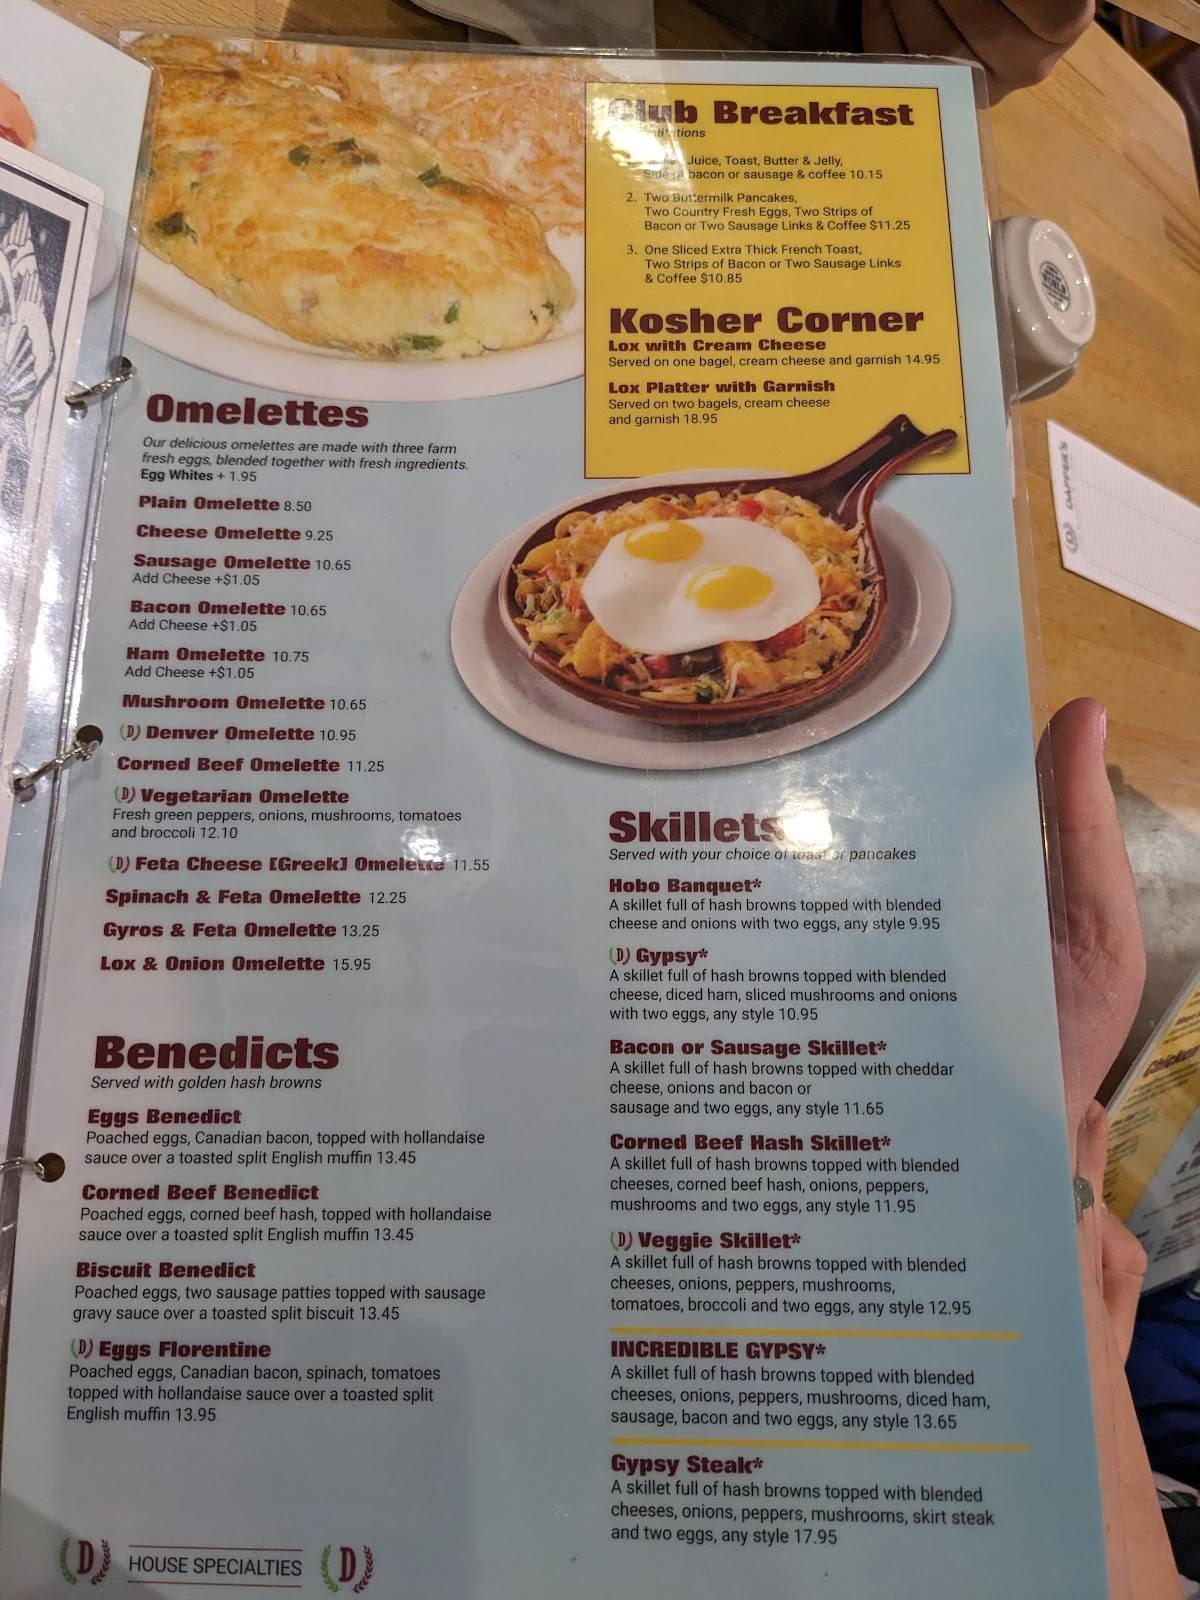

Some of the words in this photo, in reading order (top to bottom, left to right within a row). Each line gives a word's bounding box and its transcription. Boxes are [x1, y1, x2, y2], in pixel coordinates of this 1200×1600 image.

[608, 98, 698, 123] Club
[713, 100, 914, 126] Breakfast
[687, 155, 721, 166] Juice,
[724, 155, 760, 167] Toast,
[763, 155, 799, 166] Butter
[802, 155, 810, 165] &
[813, 155, 843, 168] Jelly,
[644, 220, 681, 231] Bacon
[684, 222, 696, 231] or
[699, 220, 725, 230] Two
[727, 220, 778, 233] Sausage
[781, 220, 813, 230] Links
[816, 220, 824, 230] &
[827, 220, 866, 230] Coffee
[870, 219, 910, 231] $11.25
[627, 244, 637, 255] 3.
[644, 245, 668, 255] One
[672, 244, 708, 255] Sliced
[711, 244, 742, 255] Extra
[744, 244, 778, 254] Thick
[781, 244, 822, 255] French
[824, 244, 862, 255] Toast,
[610, 307, 762, 334] Kosher
[776, 306, 924, 333] Corner
[608, 339, 639, 352] Lox
[645, 339, 686, 352] with
[693, 339, 752, 351] Cream
[758, 338, 826, 351] Cheese
[608, 356, 650, 367] Served
[653, 359, 669, 367] on
[672, 358, 696, 367] one
[699, 355, 735, 368] bagel,
[739, 357, 778, 366] cream
[781, 355, 825, 366] cheese
[829, 354, 852, 365] and
[855, 354, 901, 367] garnish
[905, 353, 940, 364] 14.95
[608, 382, 640, 394] Lox
[646, 381, 710, 394] Platter
[715, 380, 757, 393] with
[763, 380, 835, 392] Garnish
[146, 393, 368, 428] Omelettes
[142, 436, 167, 448] Our
[169, 437, 227, 450] delicious
[230, 439, 295, 451] omelettes
[298, 443, 319, 452] are
[321, 441, 358, 453] made
[361, 442, 388, 453] with
[392, 442, 424, 454] three
[428, 442, 456, 454] farm
[138, 495, 187, 509] Plain
[193, 496, 280, 511] Omelette
[284, 500, 311, 512] 8.50
[136, 524, 208, 539] Cheese
[214, 526, 301, 540] Omelette
[305, 529, 333, 541] 9.25
[133, 553, 217, 571] Sausage
[223, 555, 311, 570] Omelette
[315, 559, 351, 571] 10.65
[132, 572, 159, 584] Add
[162, 572, 211, 585] Cheese
[214, 573, 260, 586] +$1.05
[122, 694, 229, 709] Mushroom
[235, 695, 325, 710] Omelette
[330, 698, 366, 710] 10.65
[146, 725, 219, 740] Denver
[224, 726, 315, 741] Omelette
[320, 729, 356, 741] 10.95
[117, 756, 191, 771] Corned
[197, 757, 244, 771] Beef
[250, 757, 340, 772] Omelette
[348, 760, 384, 772] 11.25
[140, 788, 252, 806] Vegetarian
[259, 789, 349, 803] Omelette
[113, 807, 150, 820] Fresh
[154, 811, 192, 823] green
[196, 811, 255, 824] peppers,
[258, 809, 307, 822] onions,
[311, 808, 395, 823] mushrooms,
[398, 810, 462, 821] tomatoes
[609, 810, 784, 842] Skillets
[609, 847, 655, 860] Served
[659, 847, 688, 860] with
[691, 850, 722, 863] your
[725, 847, 770, 860] choice
[849, 847, 916, 863] pancakes
[609, 878, 660, 893] Hobo
[105, 888, 189, 907] Spinach
[195, 890, 211, 904] &
[218, 889, 262, 904] Feta
[269, 889, 361, 904] Omelette
[369, 891, 406, 904] 12.25
[609, 916, 658, 929] cheese
[661, 916, 686, 929] and
[690, 917, 737, 929] onions
[741, 916, 769, 929] with
[773, 918, 799, 929] two
[803, 919, 840, 933] eggs,
[844, 919, 868, 933] any
[872, 916, 905, 933] style
[909, 917, 940, 930] 9.95
[94, 1035, 339, 1070] Benedicts
[610, 1039, 674, 1055] Bacon
[681, 1042, 704, 1055] or
[710, 1039, 801, 1059] Sausage
[90, 1075, 140, 1089] Served
[144, 1075, 174, 1088] with
[178, 1075, 226, 1092] golden
[230, 1075, 265, 1088] hash
[269, 1075, 322, 1089] browns
[87, 1108, 139, 1128] Eggs
[146, 1108, 242, 1124] Benedict
[86, 1130, 149, 1144] Poached
[152, 1133, 190, 1147] eggs,
[195, 1130, 261, 1144] Canadian
[266, 1130, 312, 1146] bacon,
[316, 1130, 366, 1147] topped
[370, 1130, 399, 1144] with
[404, 1130, 485, 1144] hollandaise
[610, 1133, 687, 1150] Corned
[694, 1134, 743, 1150] Beef
[750, 1134, 803, 1151] Hash
[82, 1184, 160, 1200] Corned
[167, 1184, 217, 1200] Beef
[223, 1184, 319, 1200] Benedict
[637, 1231, 713, 1252] Veggie
[76, 1261, 152, 1278] Biscuit
[158, 1261, 256, 1278] Benedict
[99, 1340, 151, 1361] Eggs
[158, 1341, 271, 1358] Florentine
[611, 1340, 738, 1359] INCREDIBLE
[610, 1385, 676, 1403] cheeses,
[680, 1390, 734, 1405] onions,
[738, 1391, 802, 1407] peppers,
[807, 1389, 901, 1408] mushrooms,
[906, 1391, 947, 1407] diced
[952, 1391, 990, 1409] ham,
[611, 1453, 680, 1477] Gypsy
[129, 1555, 188, 1573] HOUSE
[193, 1557, 302, 1576] SPECIALTIES
